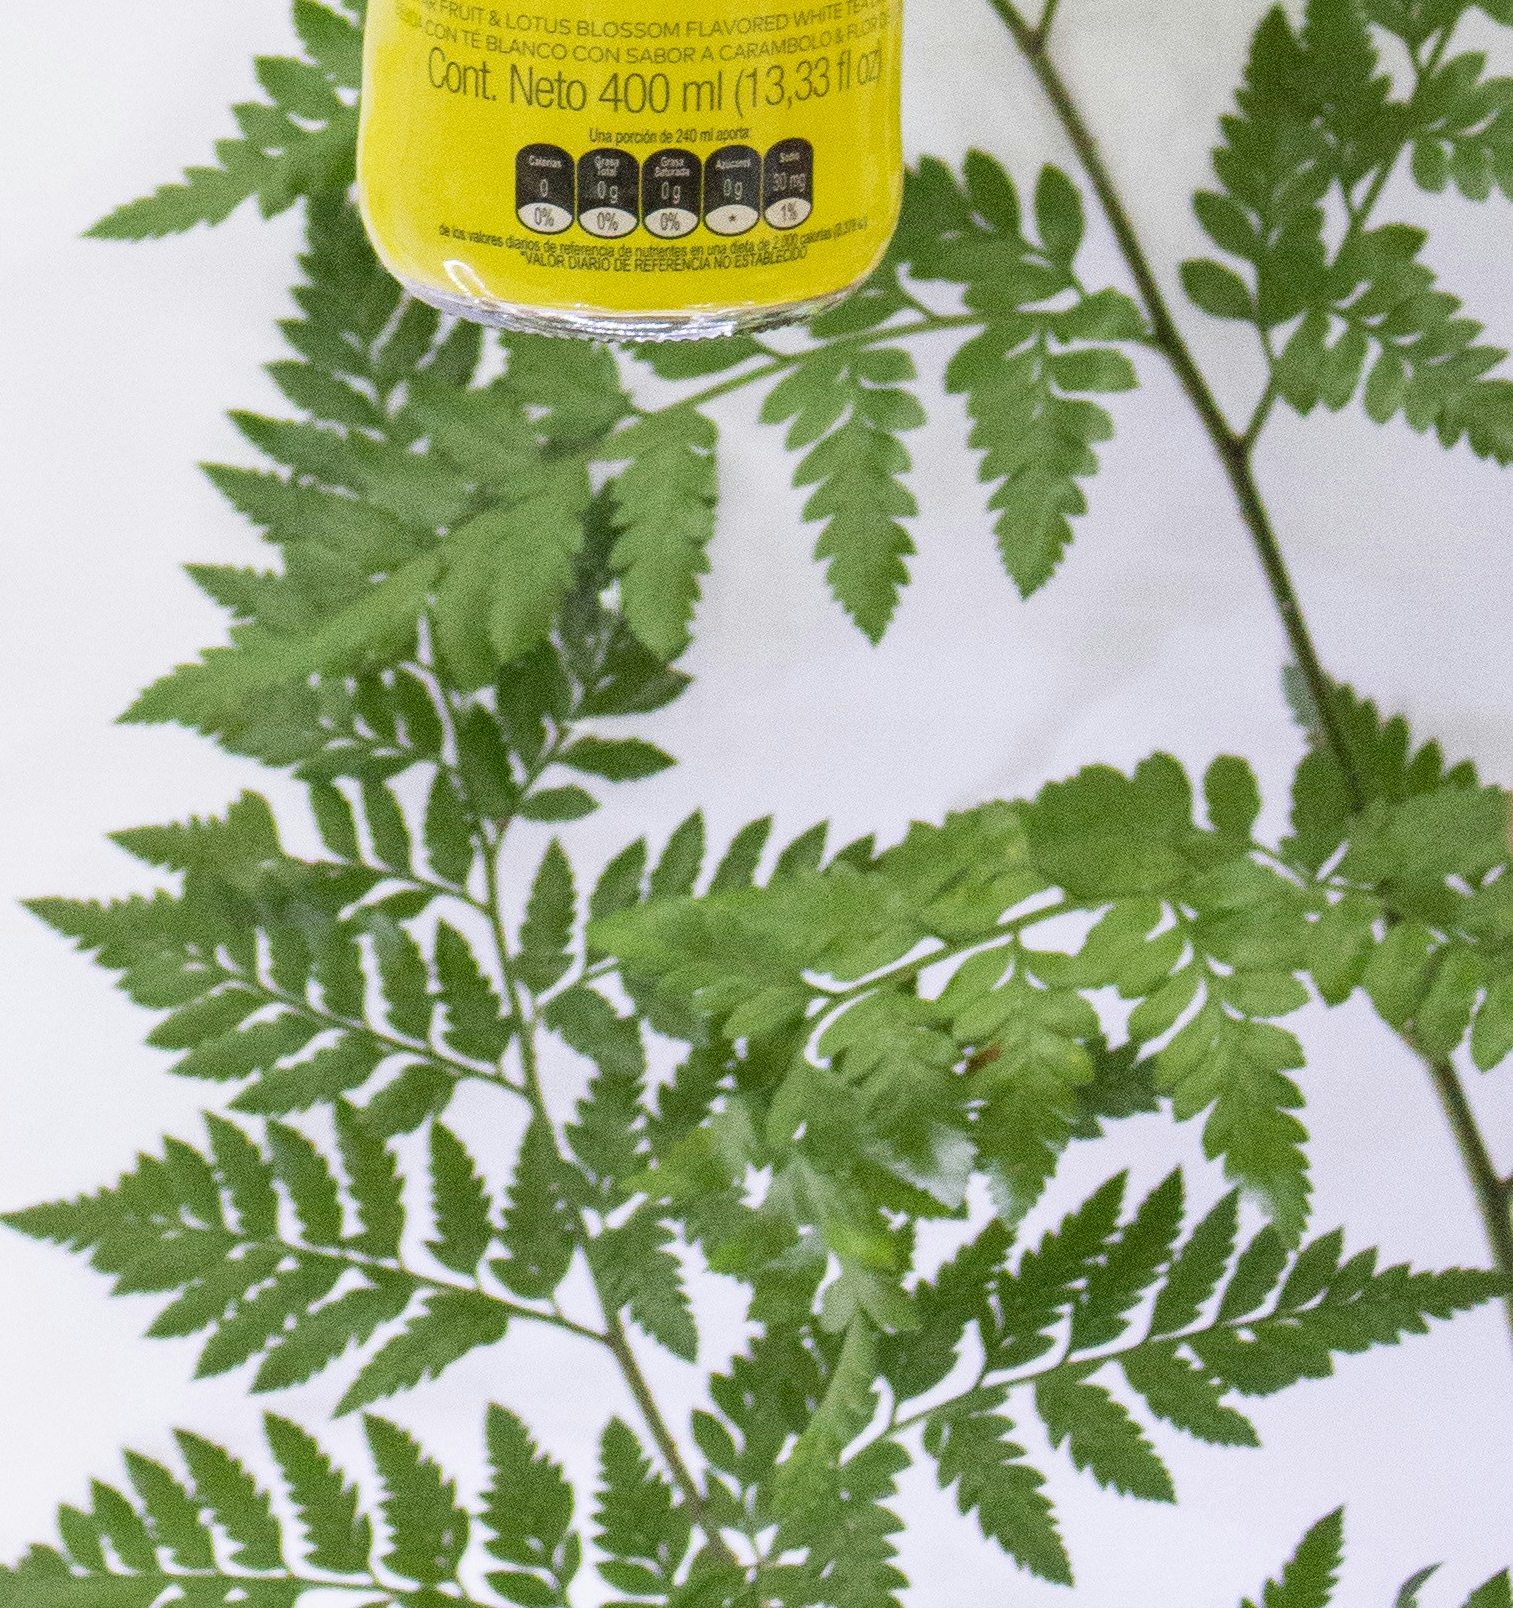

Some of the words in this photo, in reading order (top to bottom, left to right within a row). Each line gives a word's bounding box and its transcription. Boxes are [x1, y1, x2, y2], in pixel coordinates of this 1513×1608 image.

[489, 10, 502, 28] &
[506, 12, 571, 35] LOTUS
[576, 20, 680, 39] BLOSSOM
[686, 13, 789, 38] FLAVORED
[792, 2, 842, 28] WHITE
[486, 34, 568, 60] BLANCO
[572, 45, 620, 64] CON
[626, 45, 696, 65] SABOR
[700, 46, 715, 63] A
[719, 29, 832, 63] CARAMBOLO
[429, 46, 497, 102] Cont.
[509, 63, 587, 112] Neto
[599, 72, 670, 114] 400
[682, 70, 723, 113] ml
[735, 56, 830, 118] (13,33
[837, 49, 851, 92] fl
[659, 129, 673, 143] de
[534, 207, 554, 227] 0%
[596, 211, 619, 231] 0%
